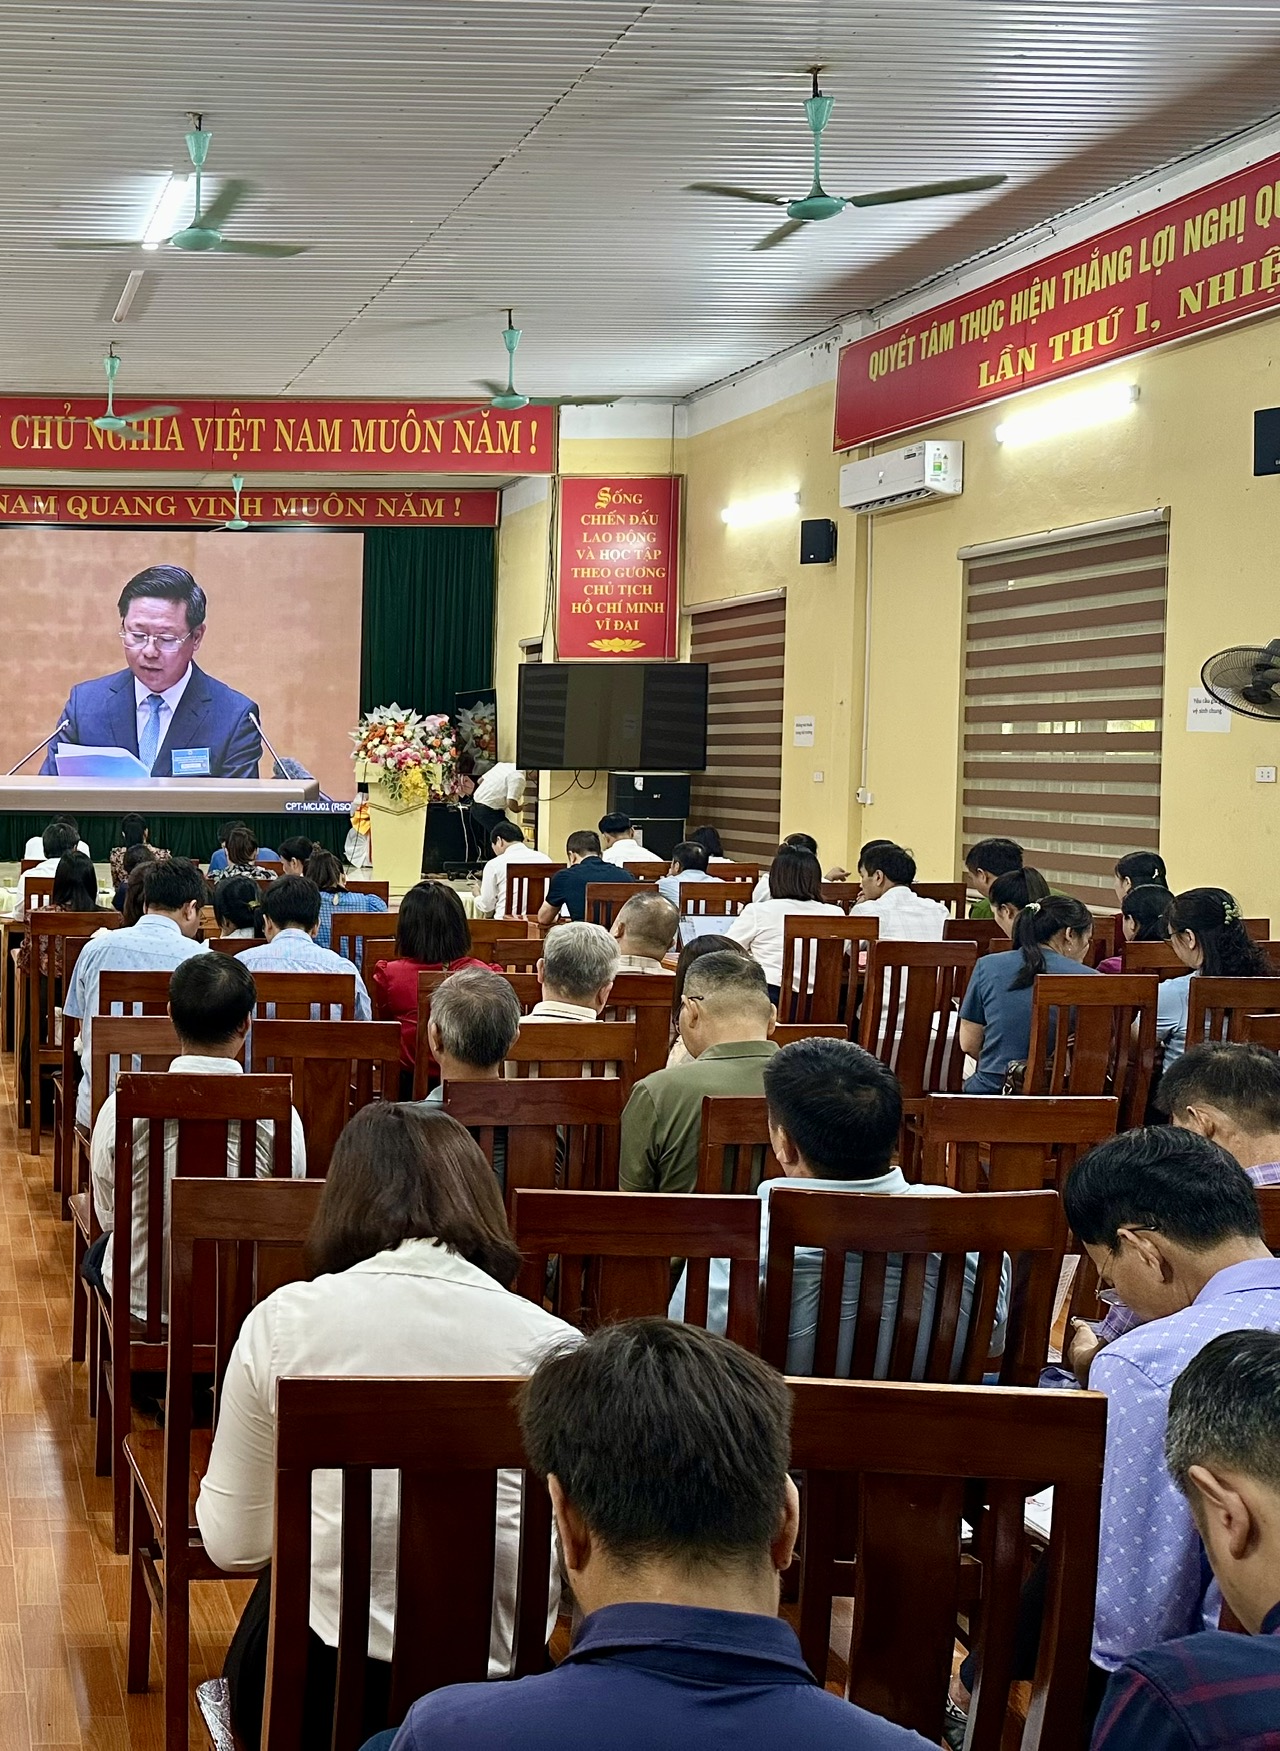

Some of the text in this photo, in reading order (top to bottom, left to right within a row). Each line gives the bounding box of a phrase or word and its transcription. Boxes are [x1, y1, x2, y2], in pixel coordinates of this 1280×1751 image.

[868, 329, 916, 382] QUYẾT
[919, 320, 955, 360] TÂM
[959, 300, 1005, 346] THỰC
[1009, 276, 1056, 326] HIỆN
[1062, 246, 1133, 305] THẮNG
[1139, 225, 1176, 276] LỢI
[1183, 195, 1246, 257] NGHỊ
[977, 342, 1038, 389] LẦN
[1048, 306, 1125, 364] THỨ
[10, 403, 78, 450] CHỦ
[192, 409, 266, 461] VIỆT
[274, 418, 342, 453] NAM
[350, 409, 445, 454] MUÔN
[451, 409, 523, 454] NĂM
[68, 496, 177, 517] QUANG
[185, 497, 263, 517] VINH
[272, 492, 367, 517] MUÔN
[375, 493, 445, 518] NĂM
[594, 486, 643, 509] SỐNG
[580, 509, 660, 526] CHIẾN ĐẤU
[582, 530, 657, 545] LAO ĐỘNG
[576, 548, 662, 562] VÀ HỌC TẬP
[571, 566, 666, 579] THEO GƯƠNG
[583, 581, 653, 597] CHỦ TỊCH
[571, 597, 664, 614] HỒ CHÍ MINH
[595, 618, 639, 633] VĨ ĐẠI
